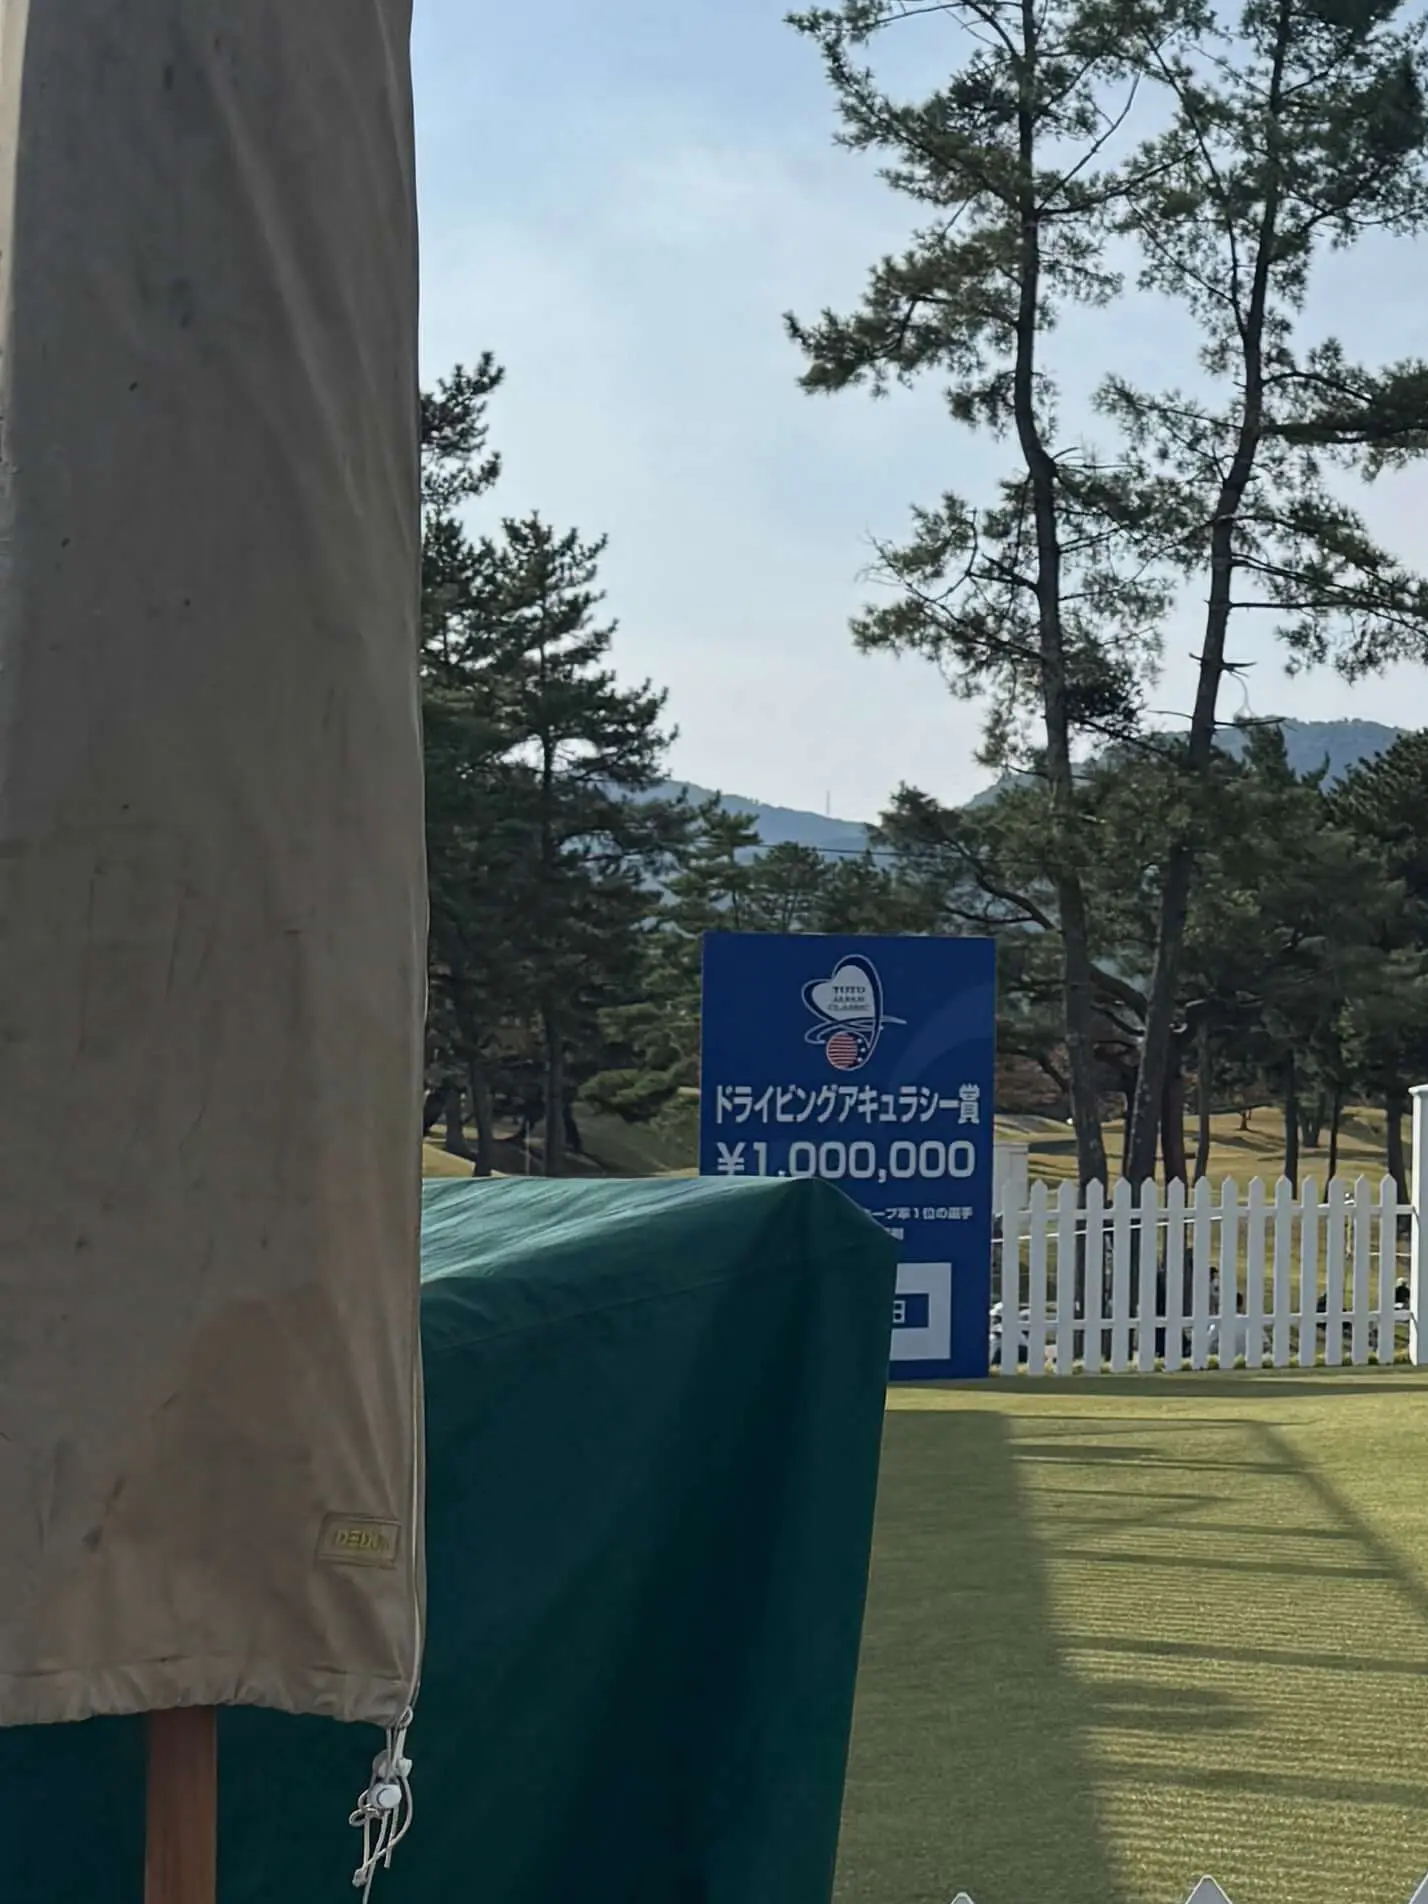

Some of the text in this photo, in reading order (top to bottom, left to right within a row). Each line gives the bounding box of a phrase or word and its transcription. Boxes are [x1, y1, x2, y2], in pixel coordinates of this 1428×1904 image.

[716, 1083, 980, 1124] ドライビングアキュラシー賞
